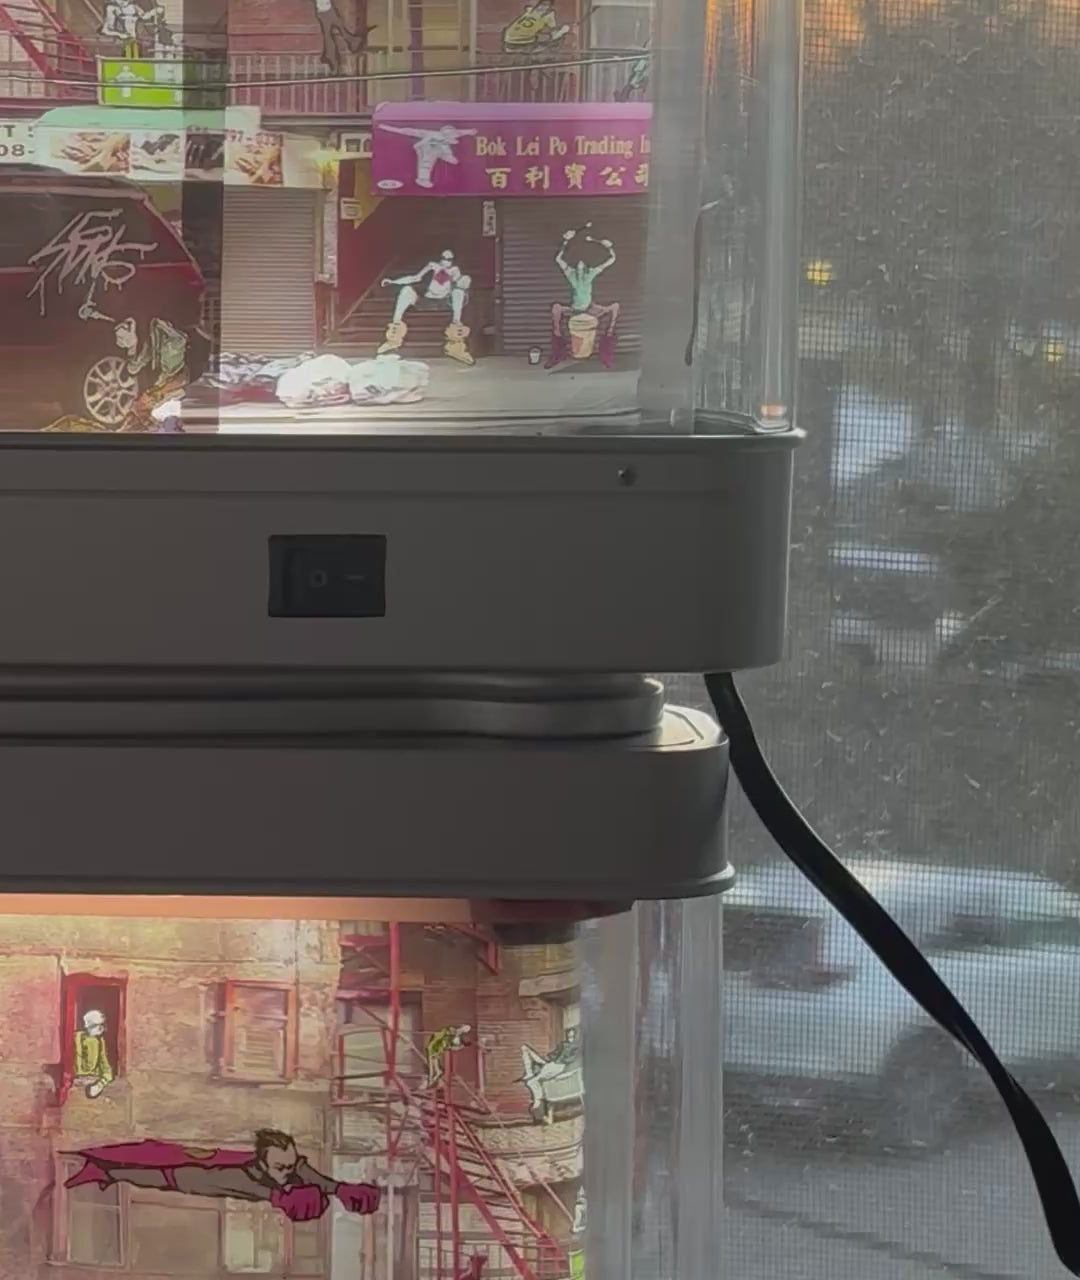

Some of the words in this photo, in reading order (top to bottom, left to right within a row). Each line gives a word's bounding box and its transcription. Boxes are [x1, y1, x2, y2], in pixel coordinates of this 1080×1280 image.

[475, 135, 507, 156] Bok
[516, 135, 540, 156] Lei
[549, 135, 568, 156] Po
[574, 135, 634, 159] Trading
